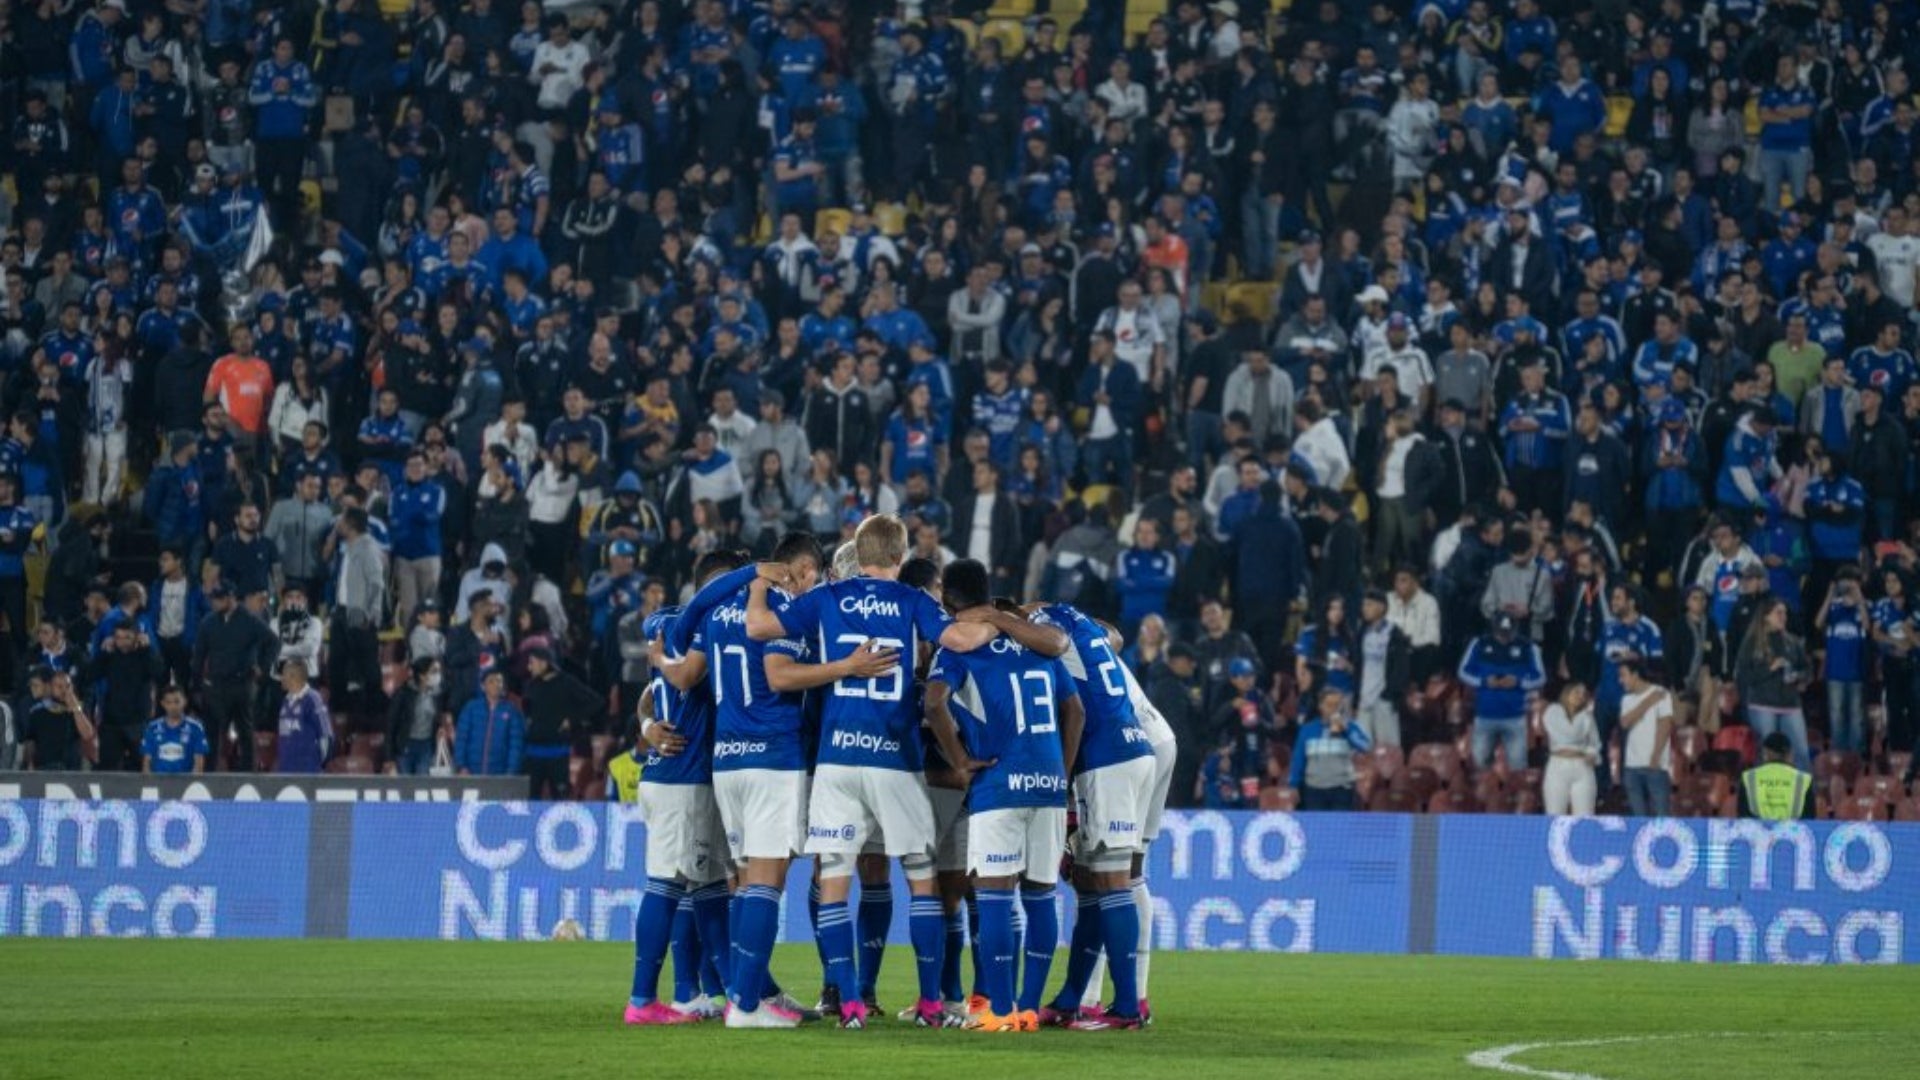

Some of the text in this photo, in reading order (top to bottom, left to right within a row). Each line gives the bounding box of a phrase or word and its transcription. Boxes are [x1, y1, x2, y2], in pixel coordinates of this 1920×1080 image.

[713, 642, 753, 707] 17
[1008, 670, 1057, 735] 13
[832, 730, 900, 753] Wplay.co
[1547, 815, 1893, 891] Como
[1532, 885, 1903, 964] Nunca
